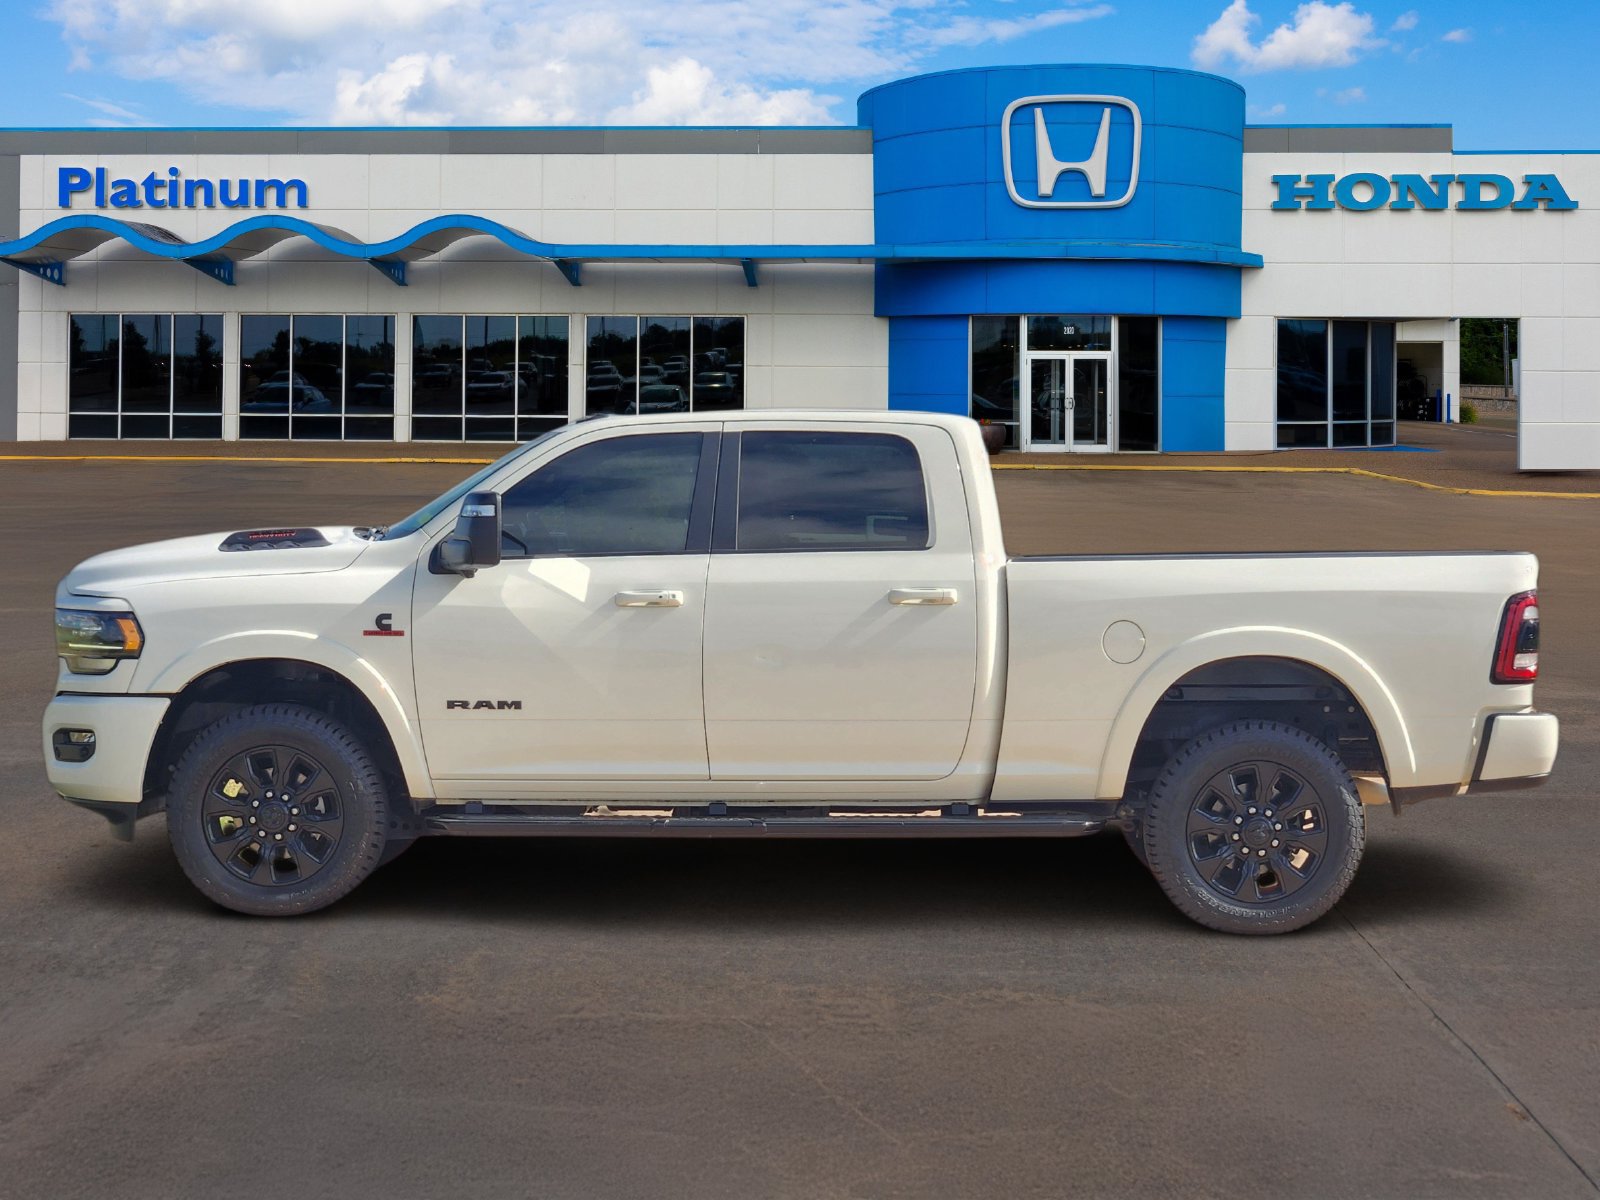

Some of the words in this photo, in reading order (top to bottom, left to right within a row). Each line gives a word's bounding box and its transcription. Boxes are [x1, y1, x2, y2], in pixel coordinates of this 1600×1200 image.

[1034, 107, 1111, 197] H
[58, 166, 309, 208] Platinum
[1271, 172, 1579, 211] HONDA
[446, 700, 522, 710] RAM
